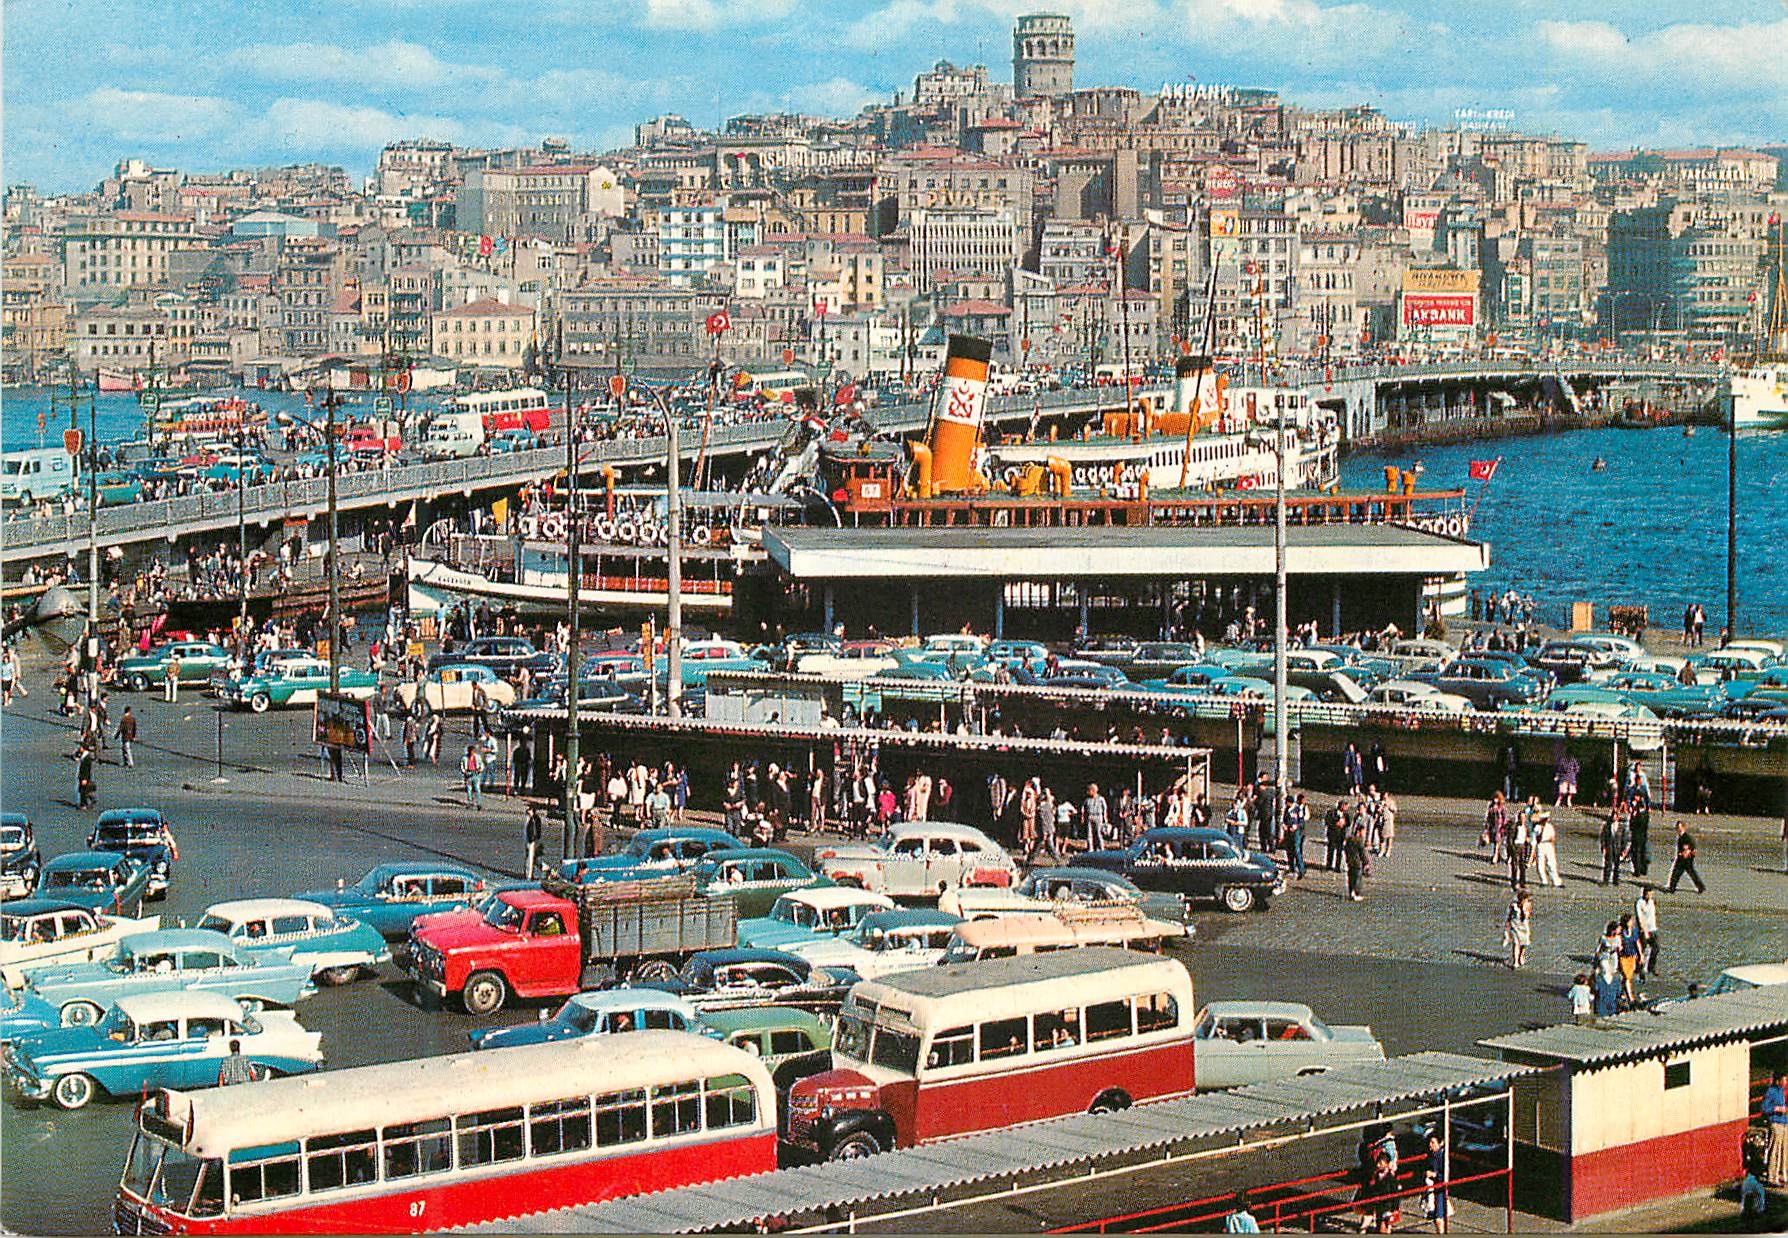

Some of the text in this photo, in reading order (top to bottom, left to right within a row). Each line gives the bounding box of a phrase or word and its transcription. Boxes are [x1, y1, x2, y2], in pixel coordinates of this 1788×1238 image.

[1160, 83, 1230, 104] AKBANK
[819, 149, 875, 166] BANKASI
[1412, 308, 1466, 322] AKBANK
[409, 1200, 426, 1217] 87
